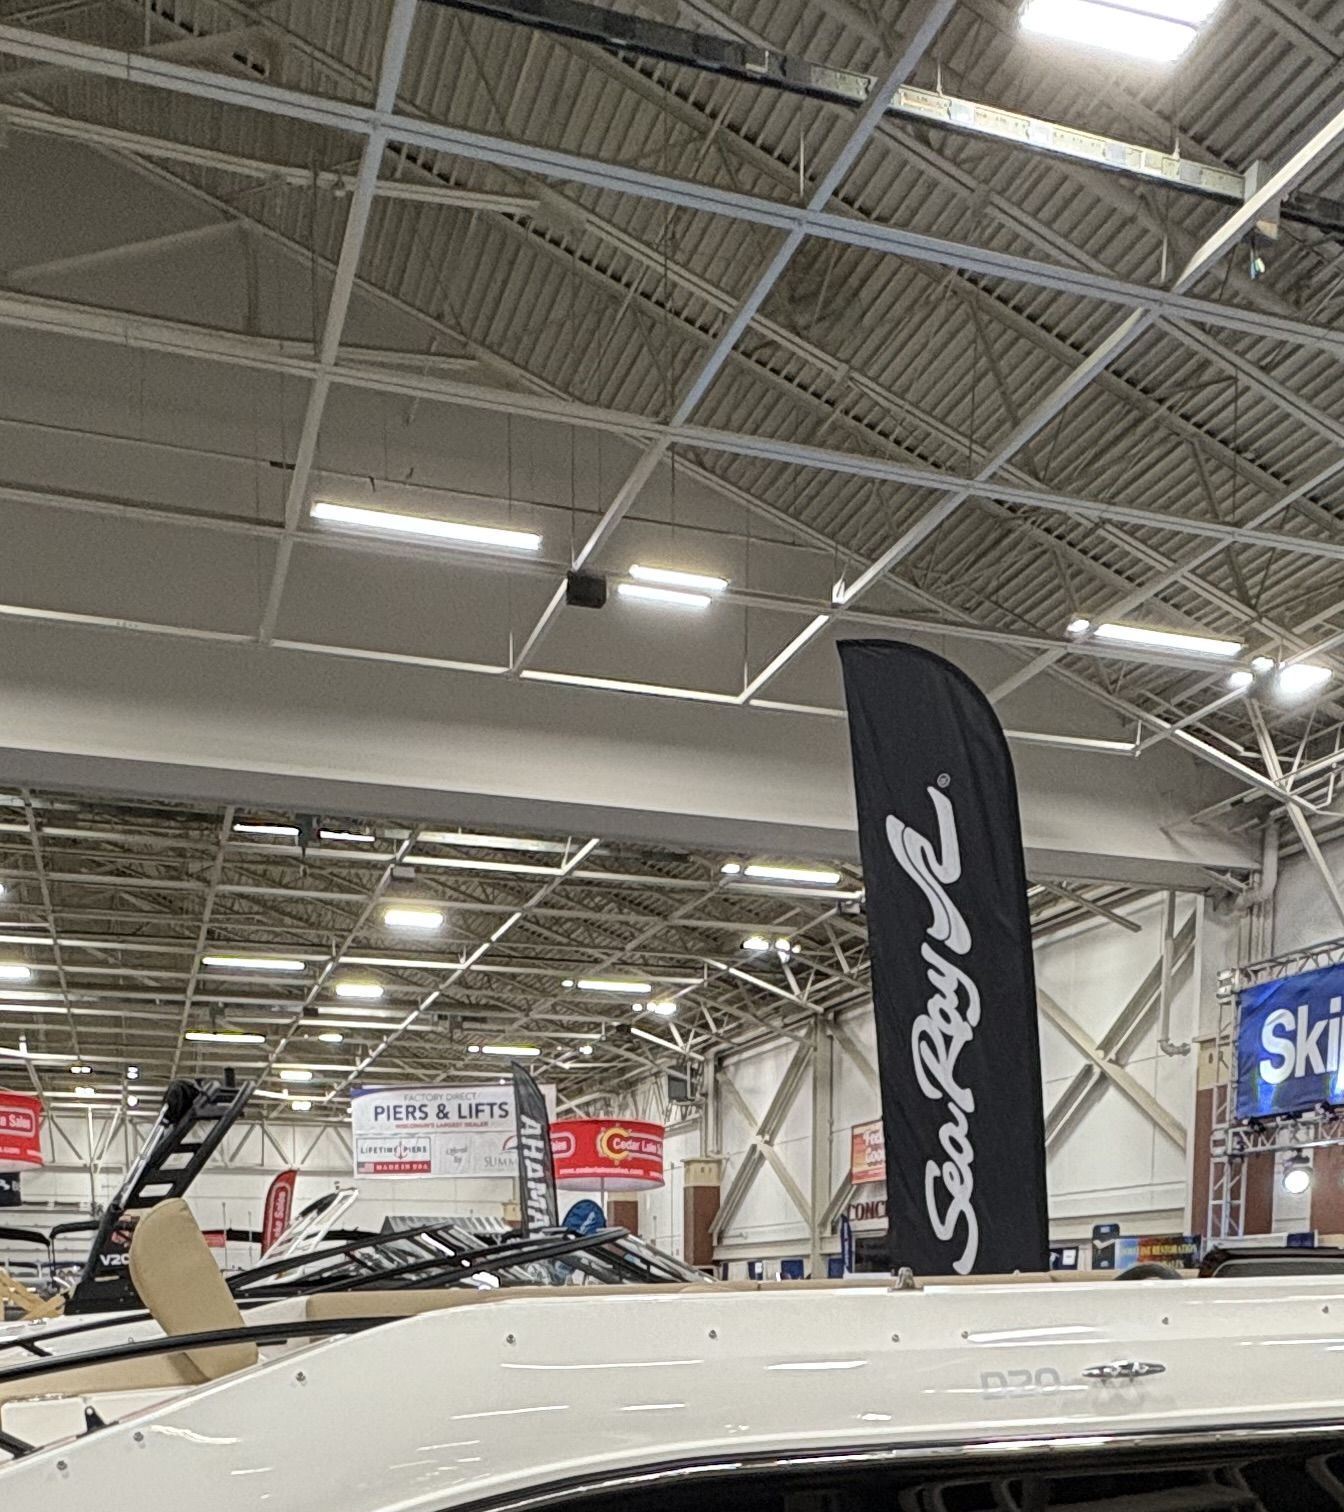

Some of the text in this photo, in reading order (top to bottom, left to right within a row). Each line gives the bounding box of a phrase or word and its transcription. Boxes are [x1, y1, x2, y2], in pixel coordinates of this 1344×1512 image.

[374, 1102, 510, 1121] PIERS & LIFTS
[911, 942, 981, 1275] Sea Ray
[484, 1156, 517, 1168] SUMM
[848, 1200, 886, 1222] CONC
